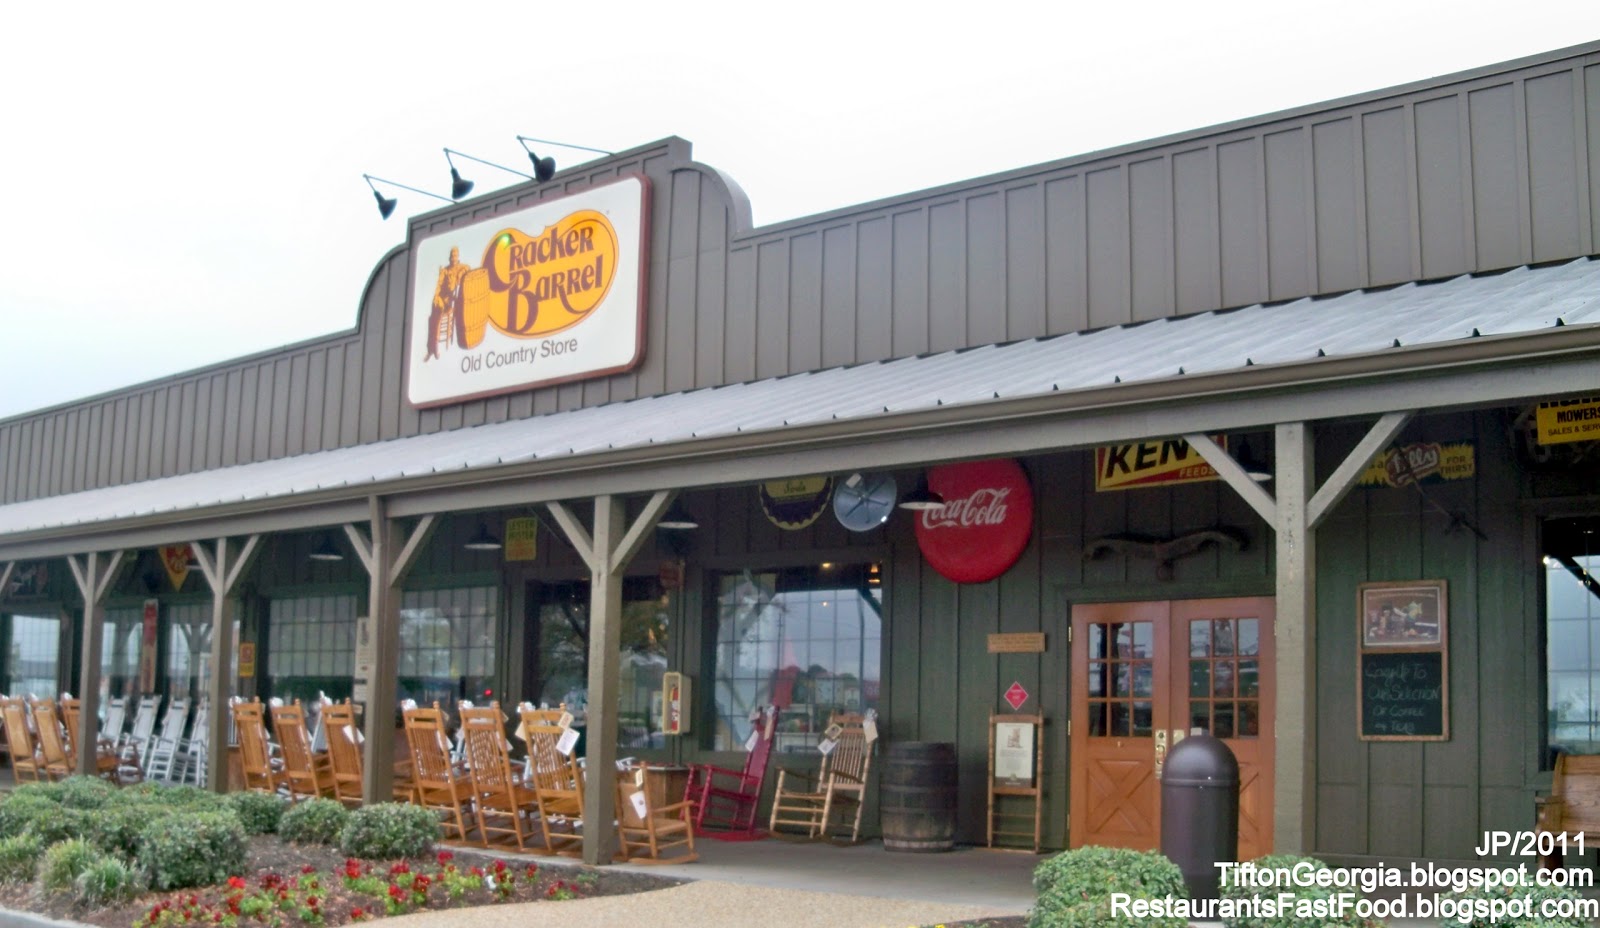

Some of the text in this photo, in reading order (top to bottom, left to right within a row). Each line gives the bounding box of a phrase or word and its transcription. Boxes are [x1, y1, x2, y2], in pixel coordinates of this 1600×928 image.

[506, 254, 603, 334] Barrel
[461, 338, 578, 374] Old Country Store
[1548, 427, 1573, 436] SALES
[1105, 440, 1200, 479] KEN
[1446, 456, 1467, 464] FOR
[1179, 465, 1216, 478] FEEDS
[1441, 463, 1473, 474] THIRST
